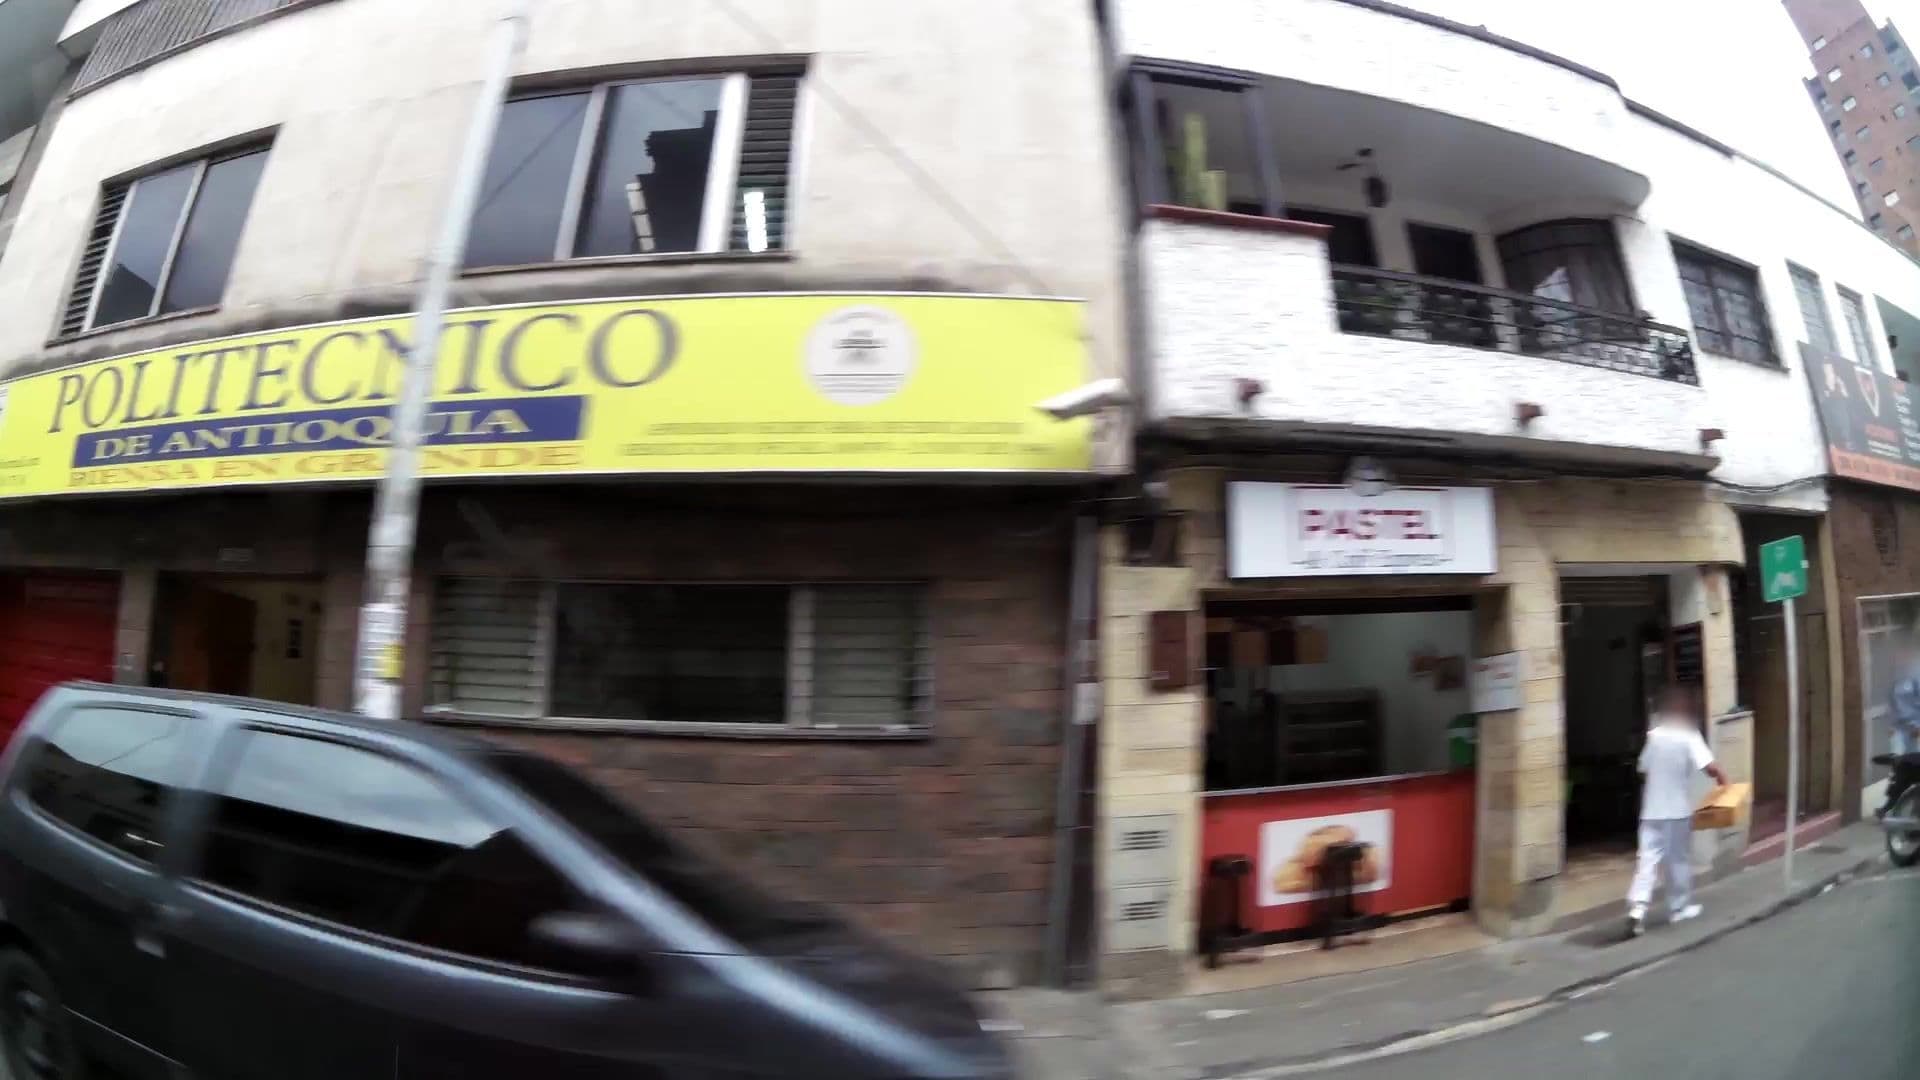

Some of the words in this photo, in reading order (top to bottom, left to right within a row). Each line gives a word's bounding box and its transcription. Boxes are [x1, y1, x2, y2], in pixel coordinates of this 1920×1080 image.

[47, 308, 681, 433] POLITECNICO
[91, 434, 153, 460] DE
[68, 461, 200, 487] PIENSA
[211, 455, 284, 479] EN
[294, 445, 585, 475] GRNDE
[1299, 509, 1443, 540] PASTEL
